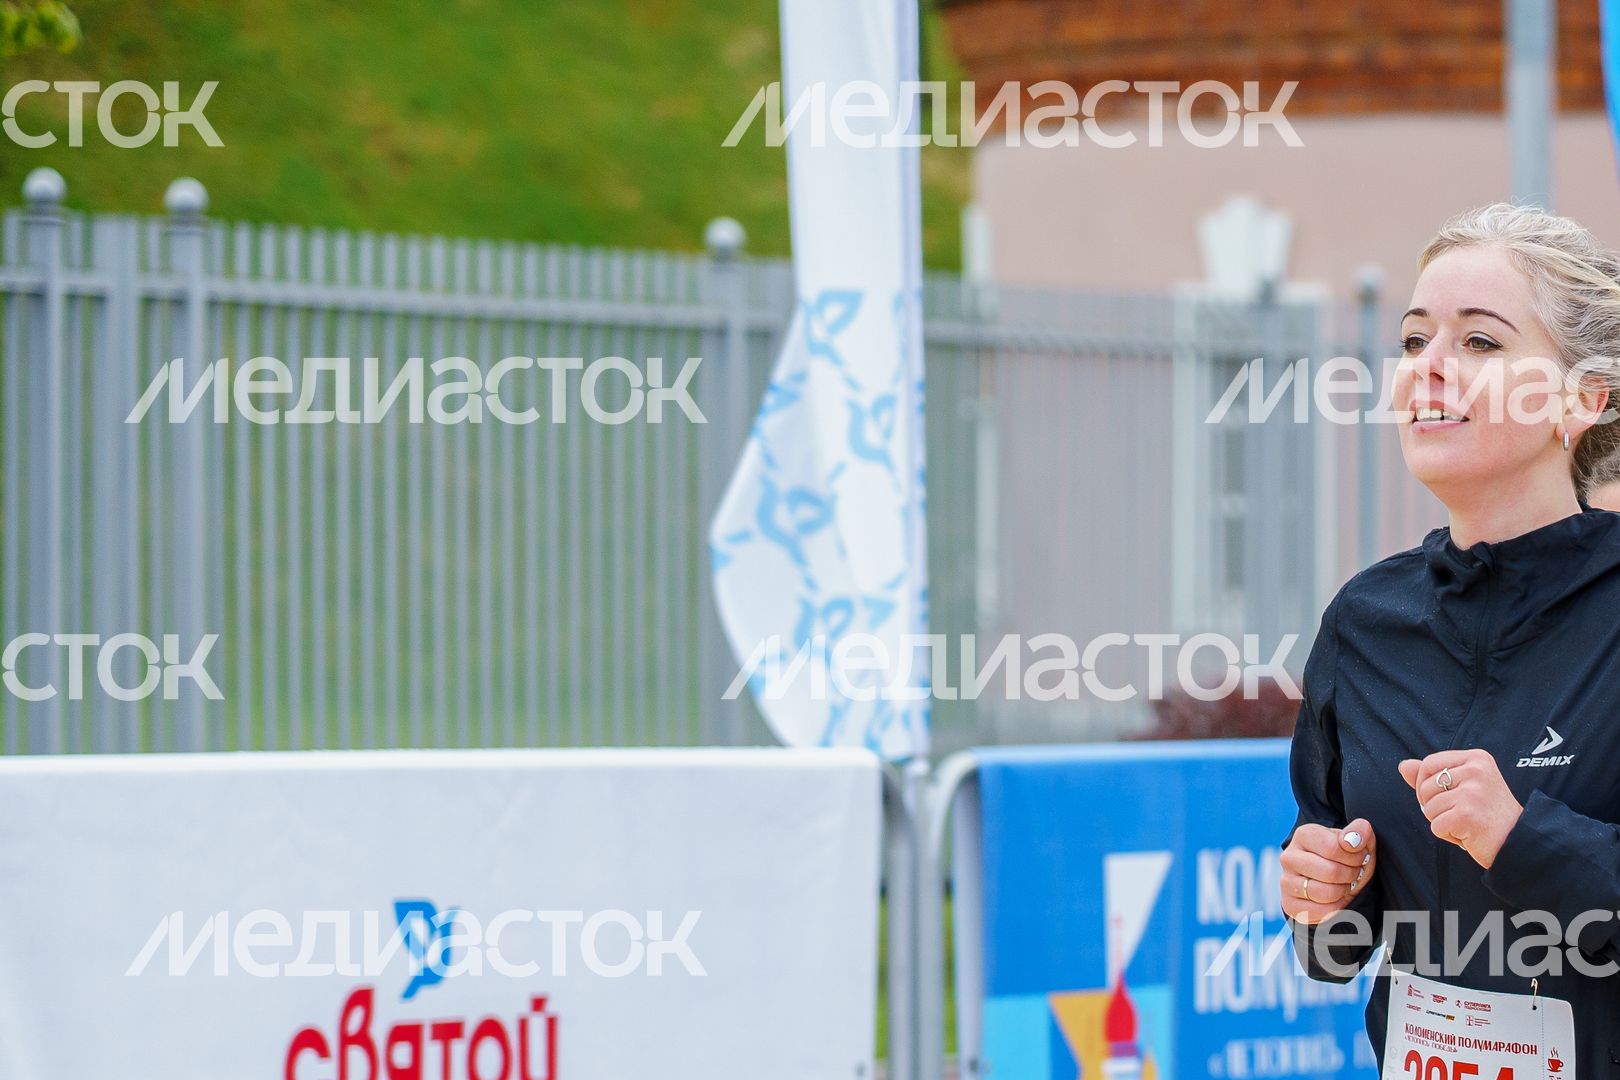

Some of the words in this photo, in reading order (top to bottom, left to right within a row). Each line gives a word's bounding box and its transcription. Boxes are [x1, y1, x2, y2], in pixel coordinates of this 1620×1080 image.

[1516, 754, 1575, 767] DEMIX
[1405, 1023, 1456, 1046] КОЛОМЕНСКИЙ
[1458, 1036, 1538, 1055] ПОЛУМАРАФОН
